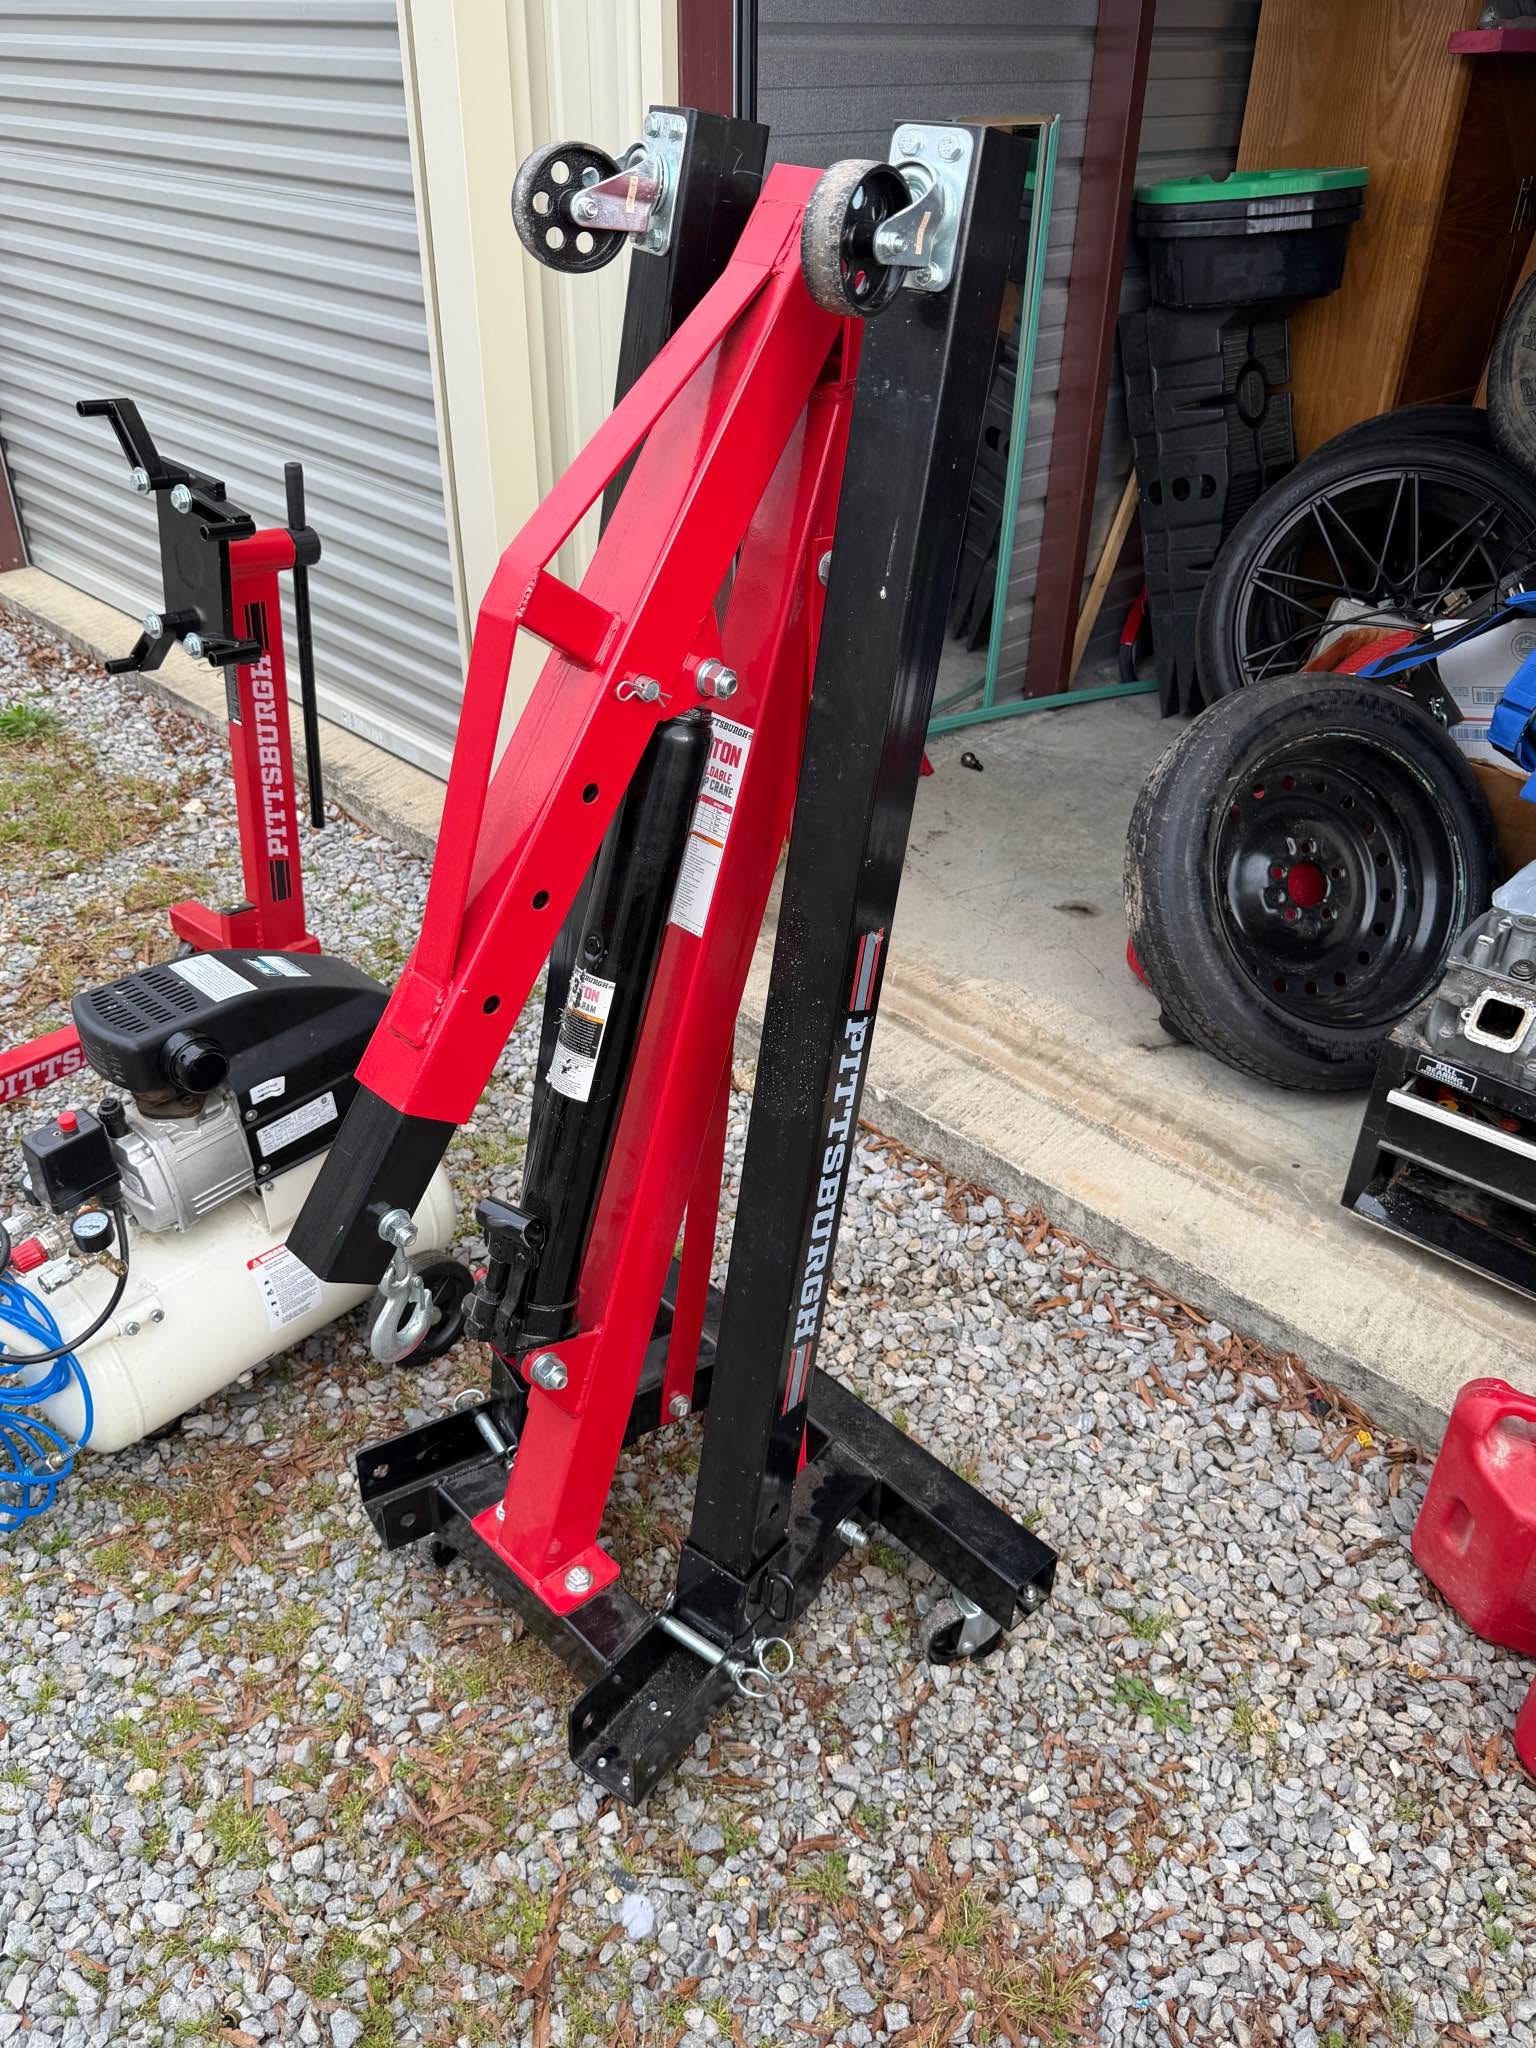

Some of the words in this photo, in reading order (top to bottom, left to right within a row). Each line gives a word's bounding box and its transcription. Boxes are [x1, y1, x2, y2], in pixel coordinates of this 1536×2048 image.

[250, 655, 289, 857] PITTSBURGH
[712, 737, 742, 769] TON
[709, 779, 734, 799] CRANE
[0, 1047, 84, 1100] ITTS
[1426, 1065, 1464, 1085] BEARING
[1435, 1063, 1457, 1076] BALL
[793, 1017, 869, 1345] PITTSBURGH
